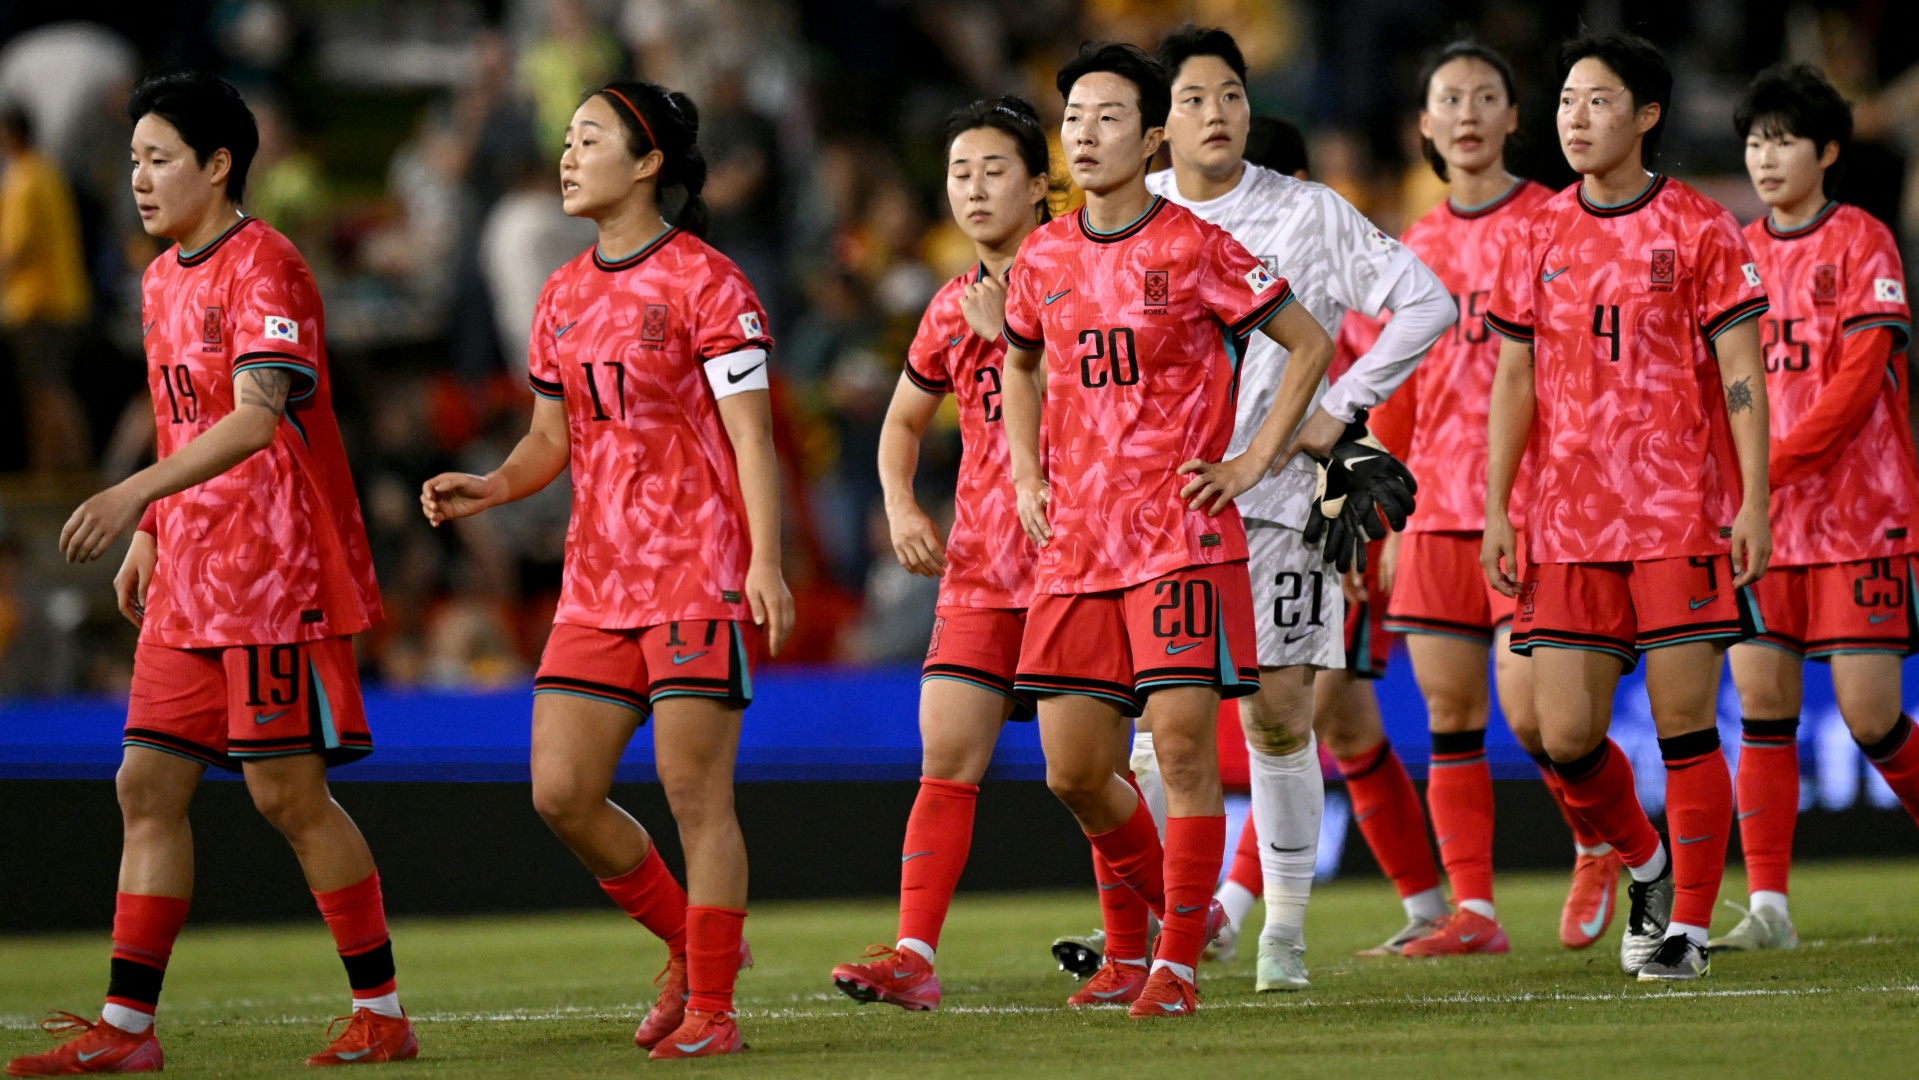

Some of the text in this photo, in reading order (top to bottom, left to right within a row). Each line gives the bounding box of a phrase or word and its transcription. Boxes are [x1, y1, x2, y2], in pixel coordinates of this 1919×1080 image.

[1143, 308, 1168, 316] KOREA
[1650, 285, 1673, 293] KOREA
[1078, 327, 1140, 389] 20
[1593, 304, 1620, 362] 4
[1762, 317, 1810, 373] 25
[160, 364, 197, 424] 19
[580, 361, 625, 421] 17
[974, 366, 1003, 422] 2
[1153, 579, 1213, 638] 20
[1273, 571, 1325, 628] 21
[243, 645, 299, 706] 19
